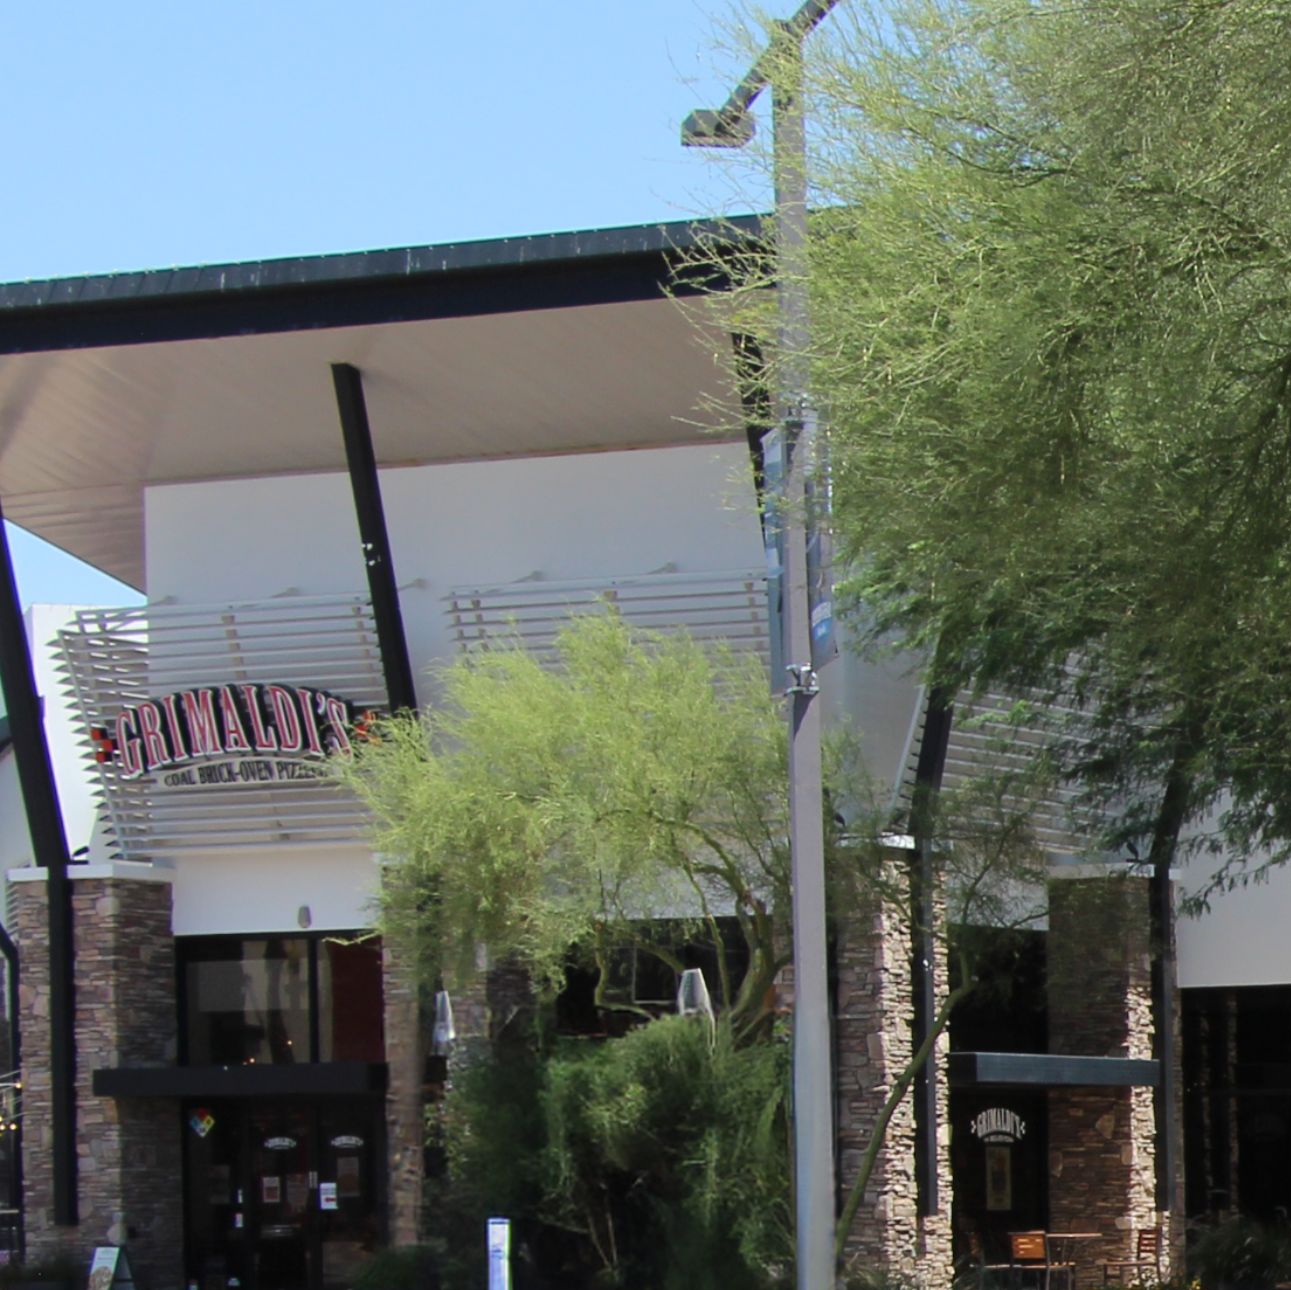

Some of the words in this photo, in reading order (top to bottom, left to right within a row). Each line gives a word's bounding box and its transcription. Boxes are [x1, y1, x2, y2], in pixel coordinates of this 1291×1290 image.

[115, 683, 354, 780] GRIMALDI'S
[164, 770, 196, 787] COAL
[198, 760, 275, 784] BRICK-OVEN
